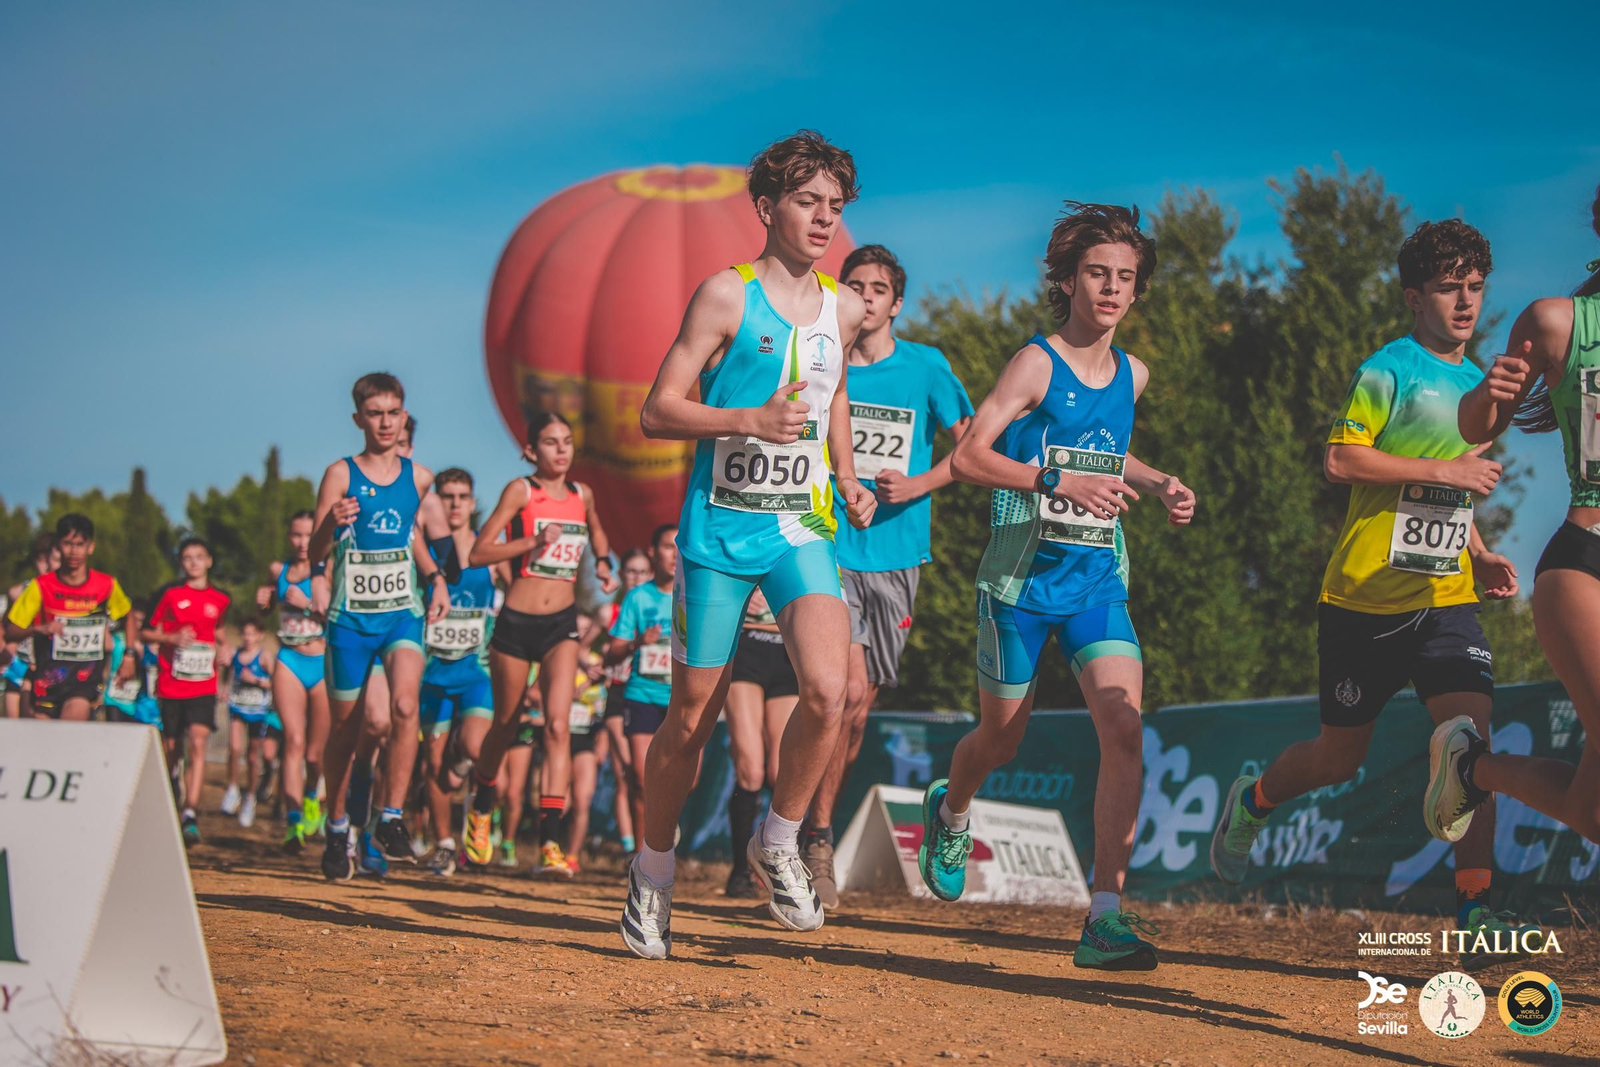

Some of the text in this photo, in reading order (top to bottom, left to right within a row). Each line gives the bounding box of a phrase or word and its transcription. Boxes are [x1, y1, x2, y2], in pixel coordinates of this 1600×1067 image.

[853, 430, 904, 459] 222
[1100, 428, 1116, 452] ORIPP
[724, 452, 810, 486] 6050
[1076, 453, 1112, 468] ITÁLICA
[1402, 516, 1466, 550] 8073
[354, 571, 406, 594] 8066
[60, 634, 99, 648] 5974
[433, 626, 480, 644] 5988
[1466, 646, 1492, 660] EVO
[23, 769, 83, 802] DE
